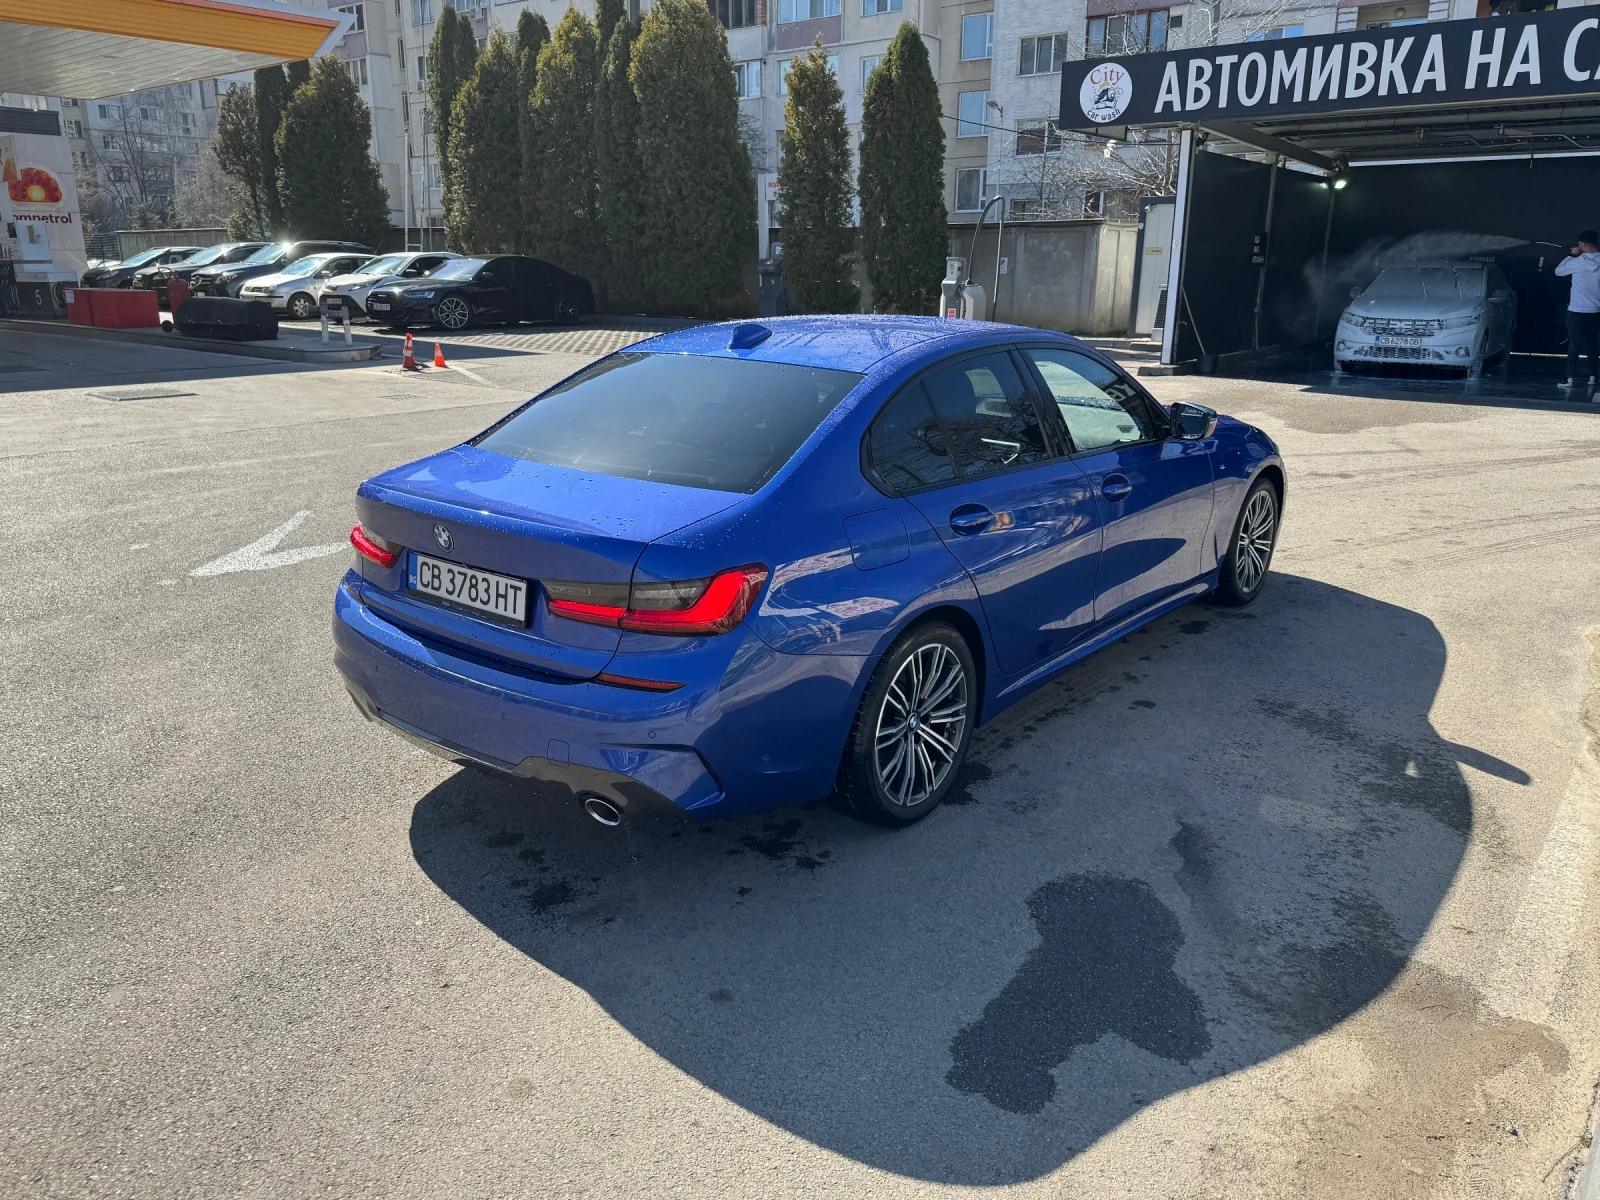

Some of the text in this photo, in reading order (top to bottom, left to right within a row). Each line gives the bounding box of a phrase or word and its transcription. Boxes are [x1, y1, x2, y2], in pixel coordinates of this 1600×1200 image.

[1153, 18, 1600, 114] АВТОМИВКА НА С
[1090, 67, 1124, 85] City
[1087, 108, 1121, 121] car wash
[12, 212, 73, 224] ompetrol
[35, 289, 42, 306] 5
[409, 574, 417, 585] BG
[419, 561, 442, 592] CB
[445, 568, 491, 606] 3783
[495, 580, 522, 615] HT
